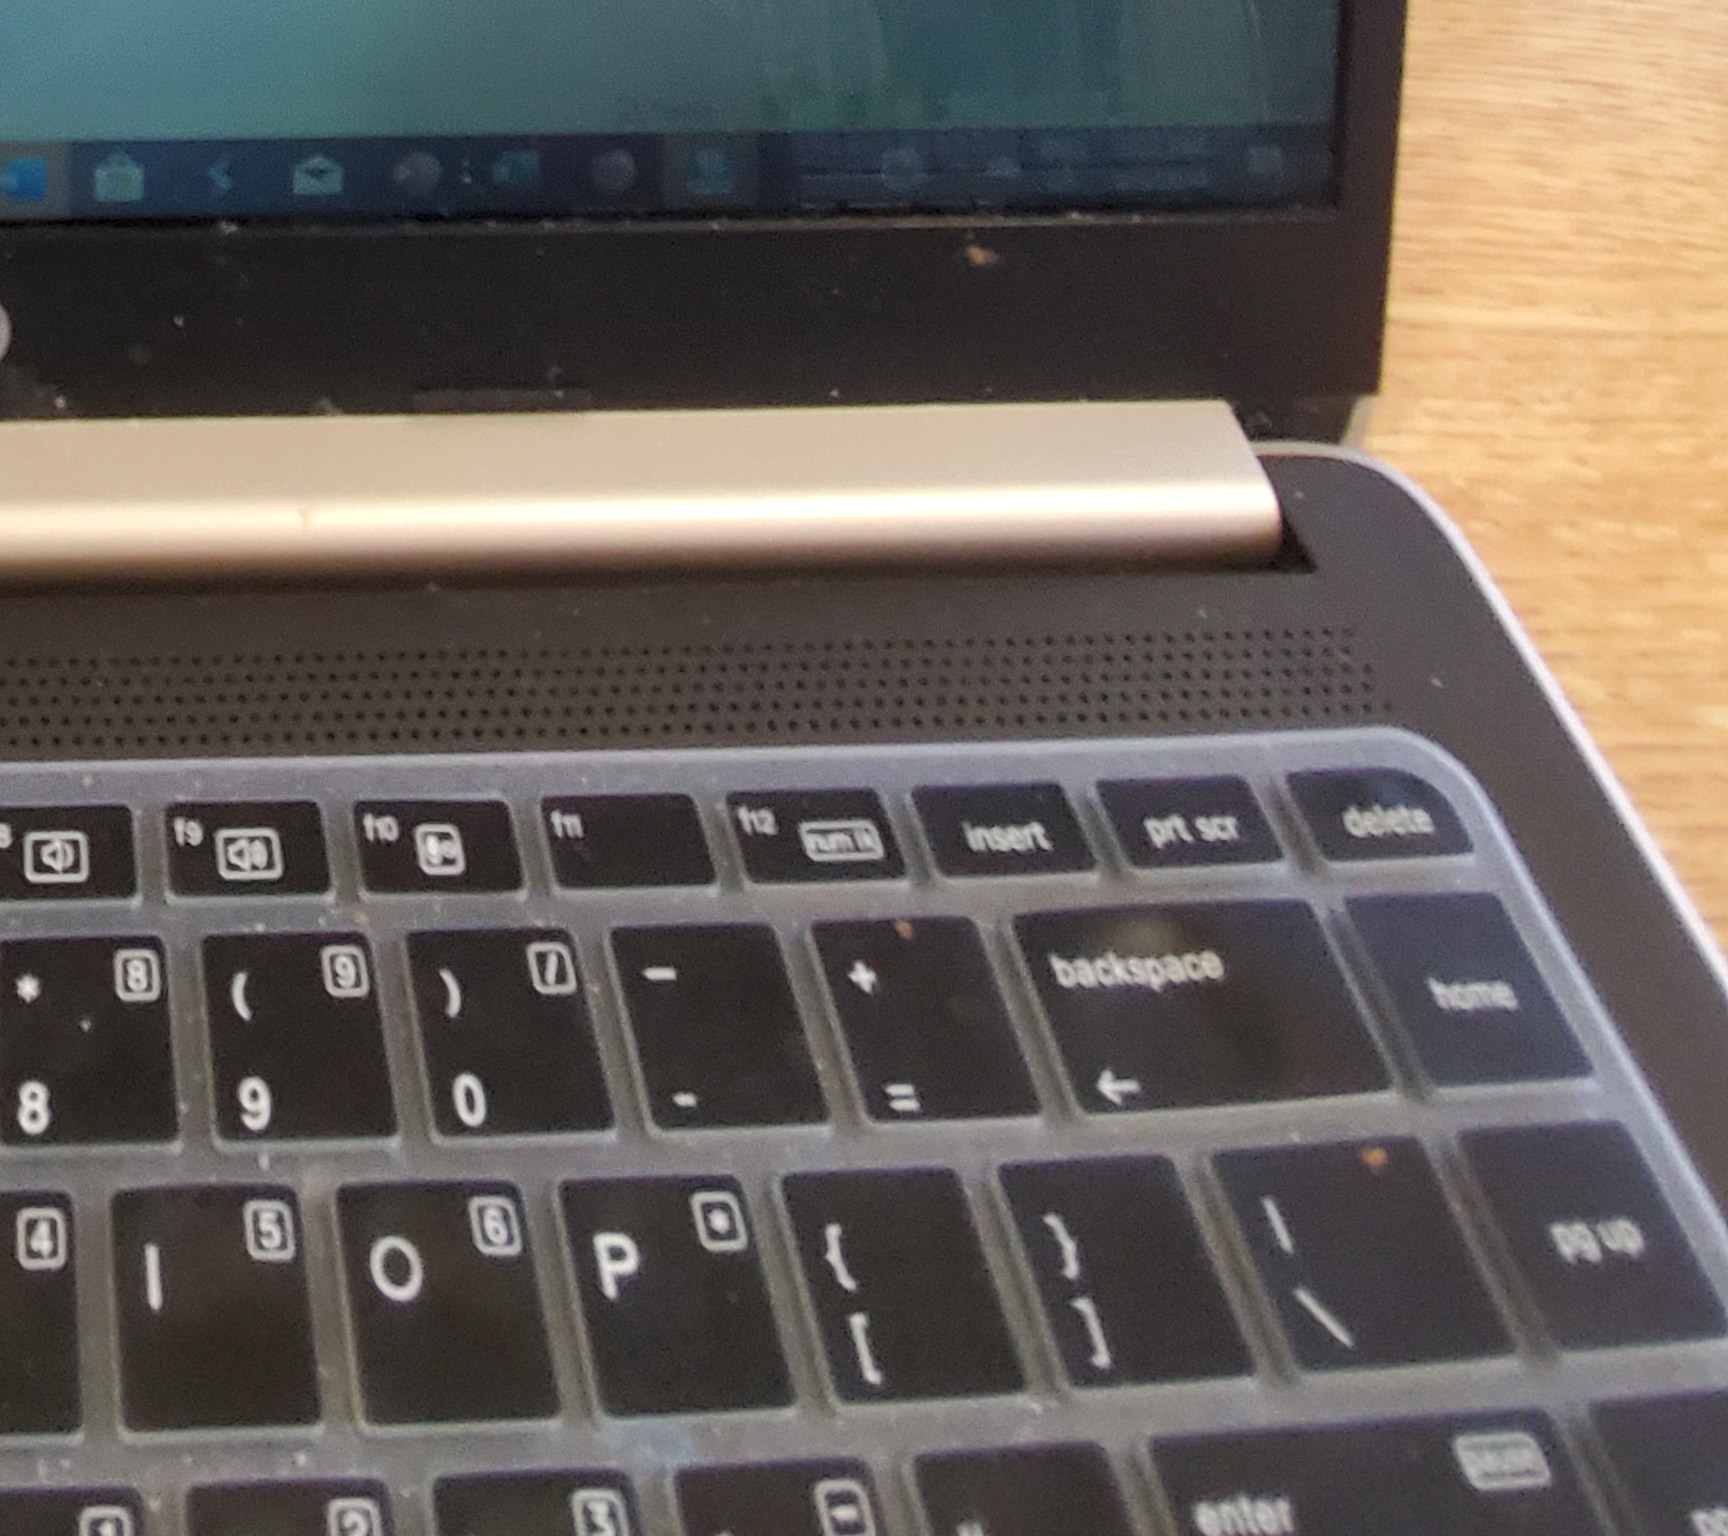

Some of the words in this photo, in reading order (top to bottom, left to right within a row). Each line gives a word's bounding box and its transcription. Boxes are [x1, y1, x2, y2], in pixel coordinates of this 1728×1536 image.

[964, 820, 1051, 852] insert
[1147, 817, 1189, 850] prt
[1198, 814, 1240, 844] scr
[1344, 802, 1435, 838] delete
[1050, 947, 1225, 994] backspace
[1433, 977, 1519, 1012] home
[17, 1081, 52, 1134] 8
[238, 1076, 273, 1131] 9
[453, 1071, 490, 1127] 0
[143, 1243, 164, 1314] I
[368, 1236, 423, 1304] O
[591, 1232, 641, 1300] P
